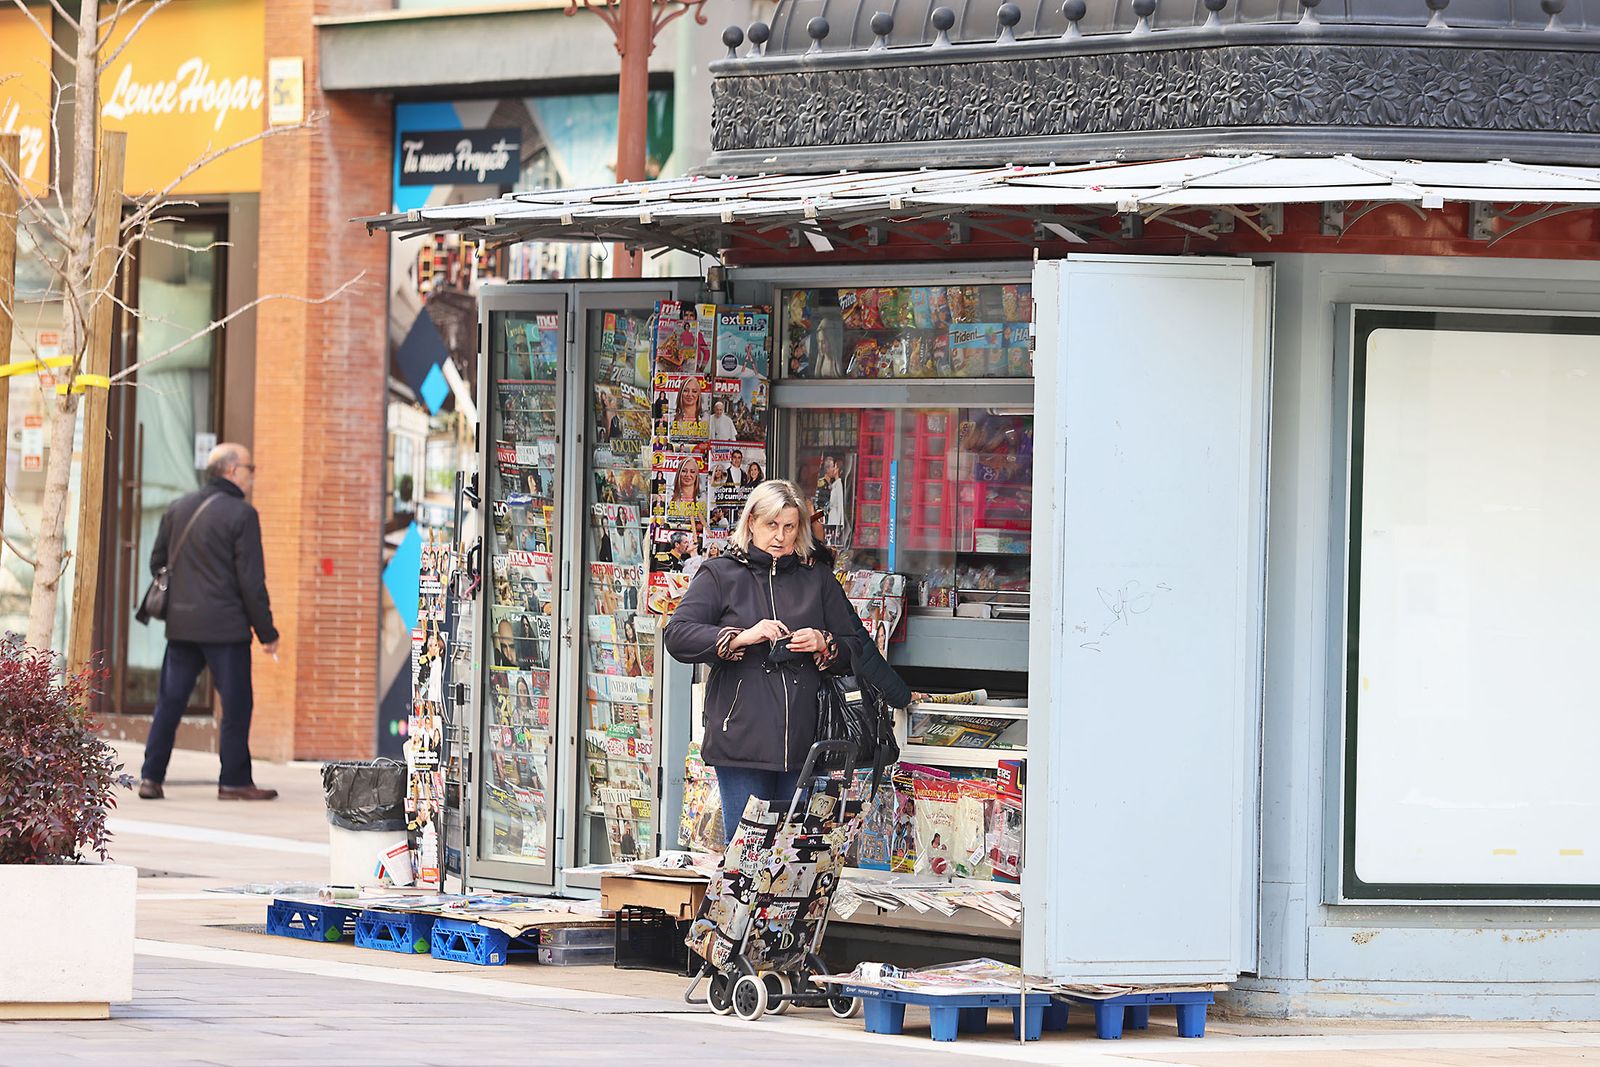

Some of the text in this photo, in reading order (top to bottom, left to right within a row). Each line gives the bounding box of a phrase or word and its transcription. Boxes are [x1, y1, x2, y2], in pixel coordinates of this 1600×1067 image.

[403, 138, 519, 183] Tu nuevo Proyecto
[951, 330, 982, 346] Trident
[715, 381, 740, 393] PAPA
[607, 505, 637, 523] CLRA
